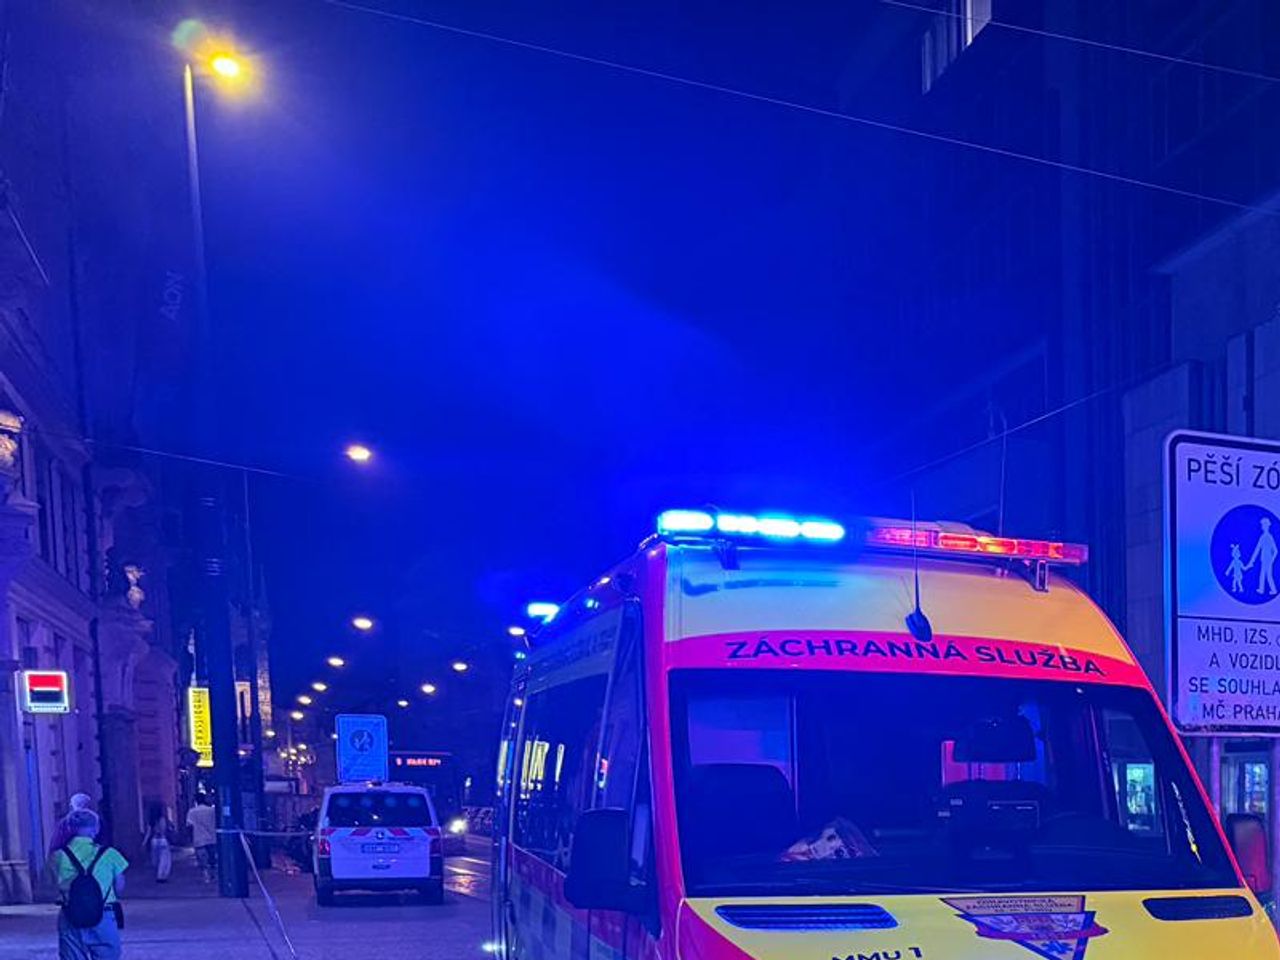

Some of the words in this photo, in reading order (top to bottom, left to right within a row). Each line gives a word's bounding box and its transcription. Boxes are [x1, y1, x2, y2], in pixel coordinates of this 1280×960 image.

[1187, 453, 1241, 487] PĚŠÍ
[725, 637, 968, 662] ZÁCHRANNÁ
[973, 645, 1107, 677] SLUŽBA
[1209, 653, 1221, 668] A
[1188, 677, 1209, 693] SE
[1202, 699, 1226, 720] MČ
[908, 947, 922, 958] 1
